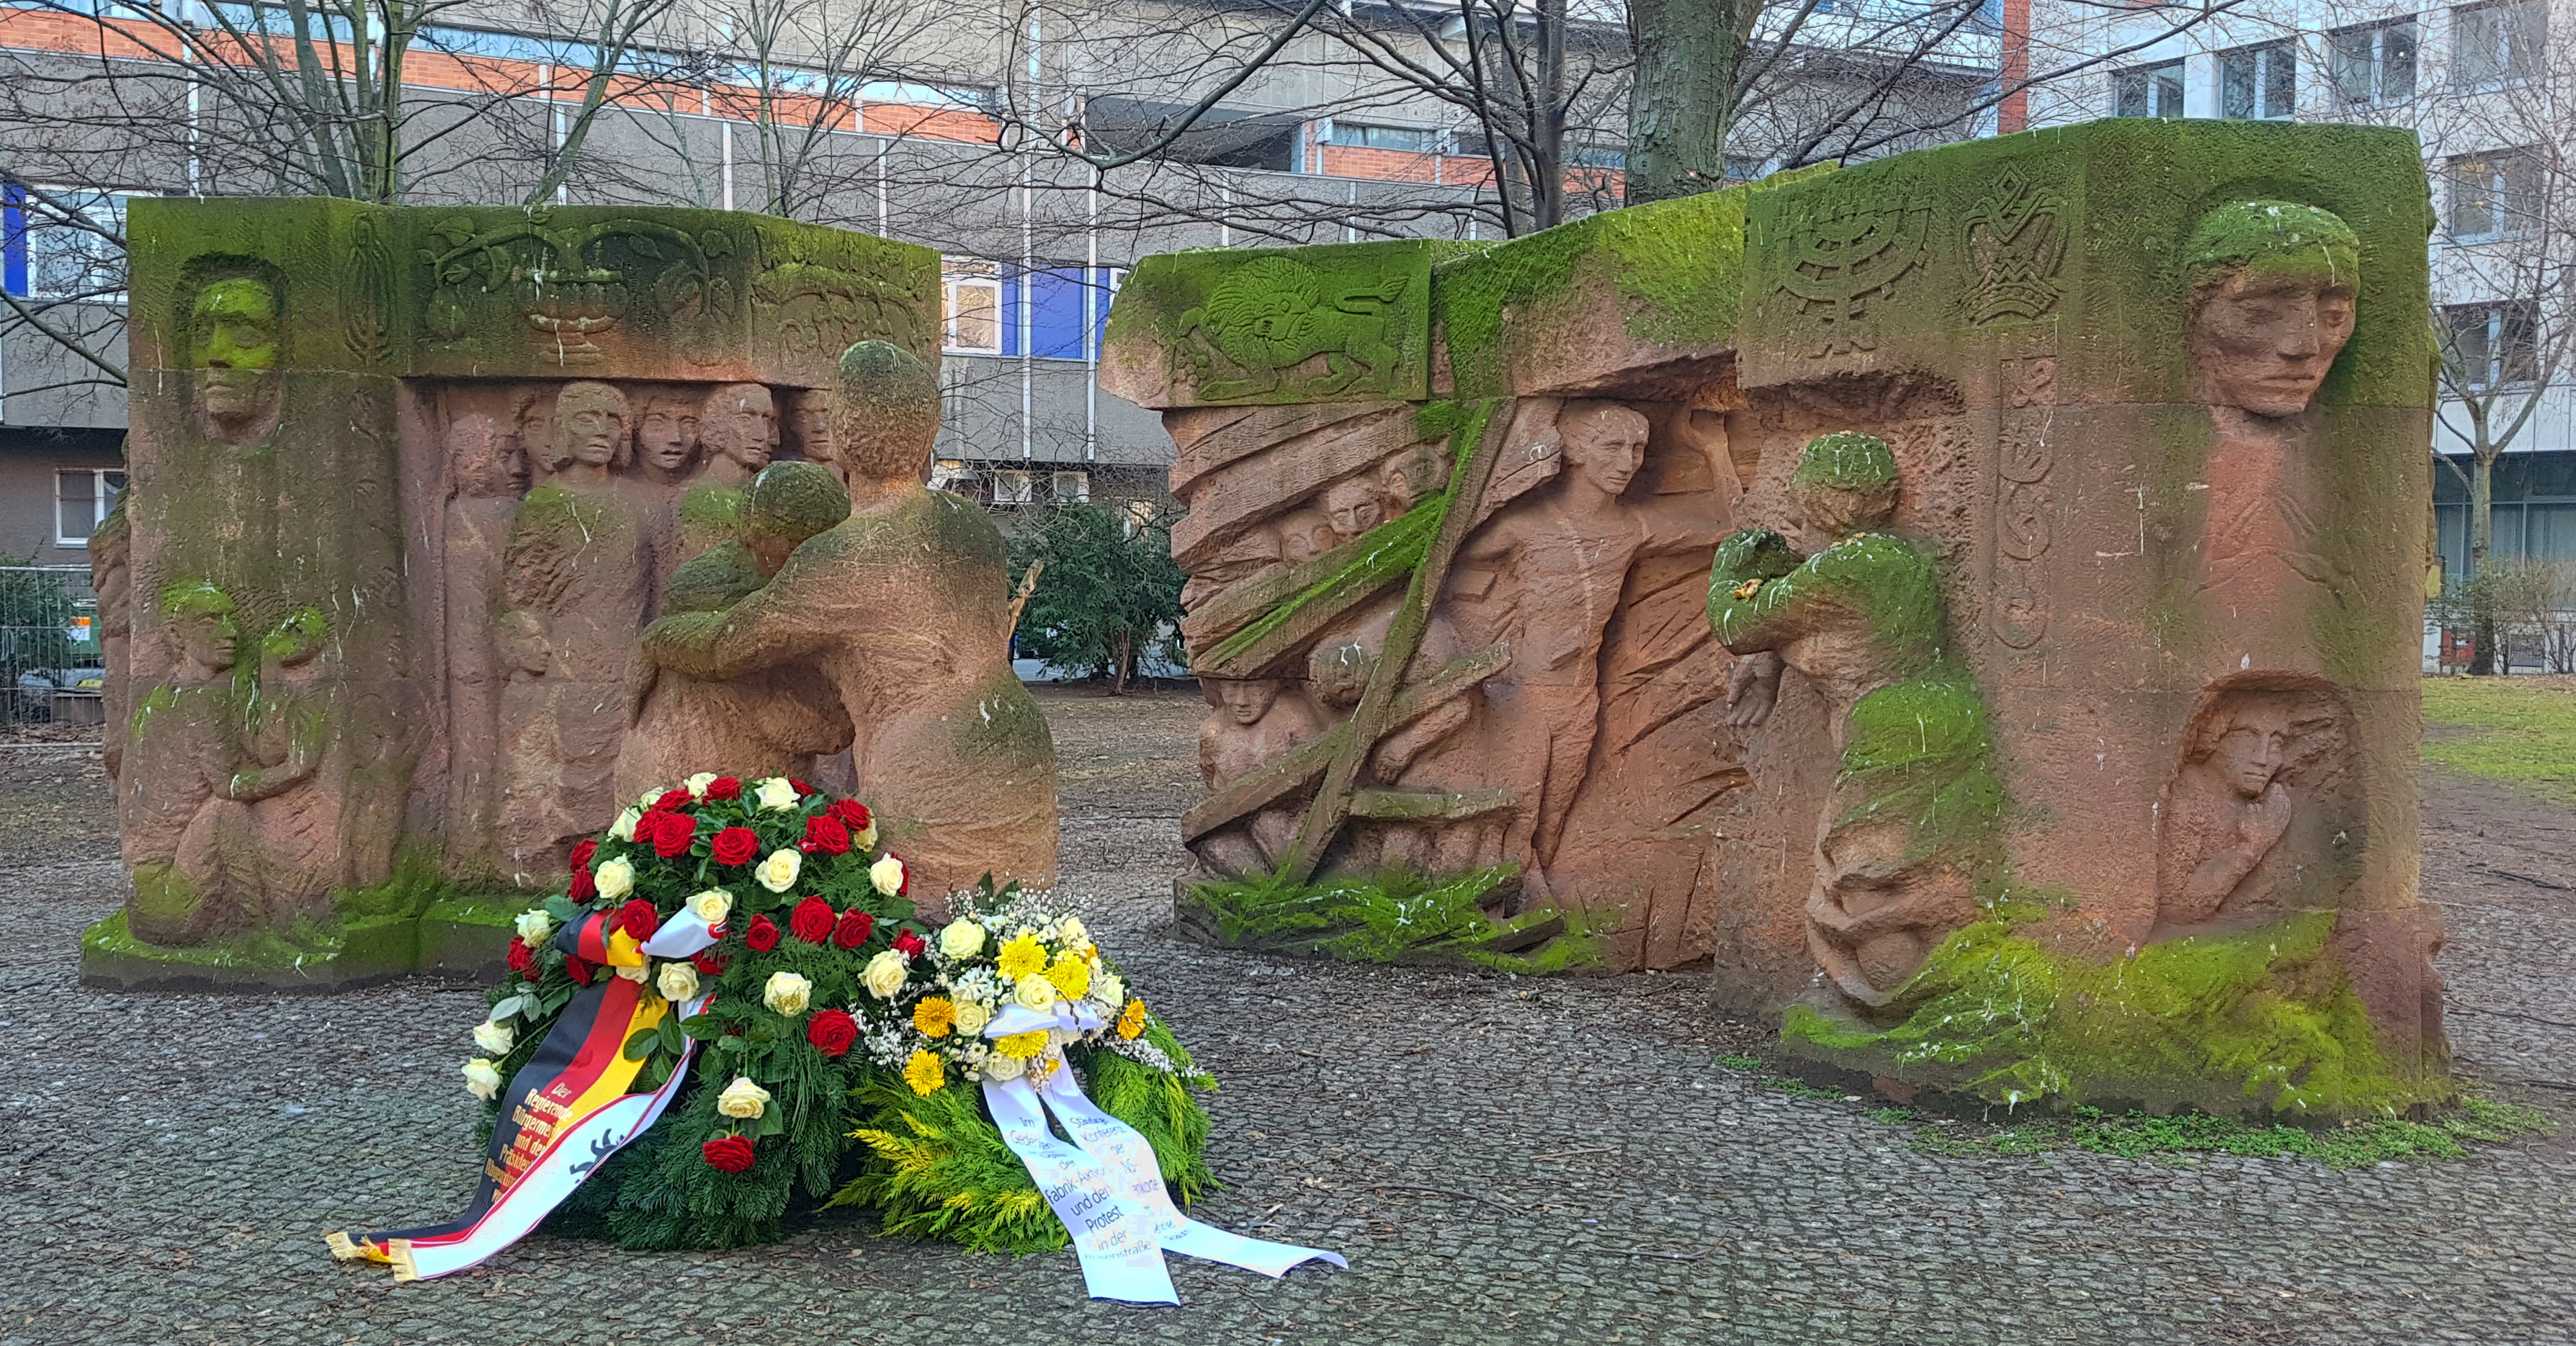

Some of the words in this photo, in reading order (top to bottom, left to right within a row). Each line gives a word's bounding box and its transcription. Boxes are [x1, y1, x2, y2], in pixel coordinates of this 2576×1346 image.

[550, 1082, 573, 1099] Der
[524, 1087, 574, 1122] Regierende
[1019, 1117, 1035, 1128] Im
[514, 1133, 533, 1152] und
[498, 1143, 534, 1172] Präsiden
[1059, 1159, 1075, 1170] der
[1070, 1193, 1093, 1216] und
[1085, 1205, 1124, 1234] Protest
[1098, 1239, 1109, 1252] in
[1110, 1229, 1127, 1247] der
